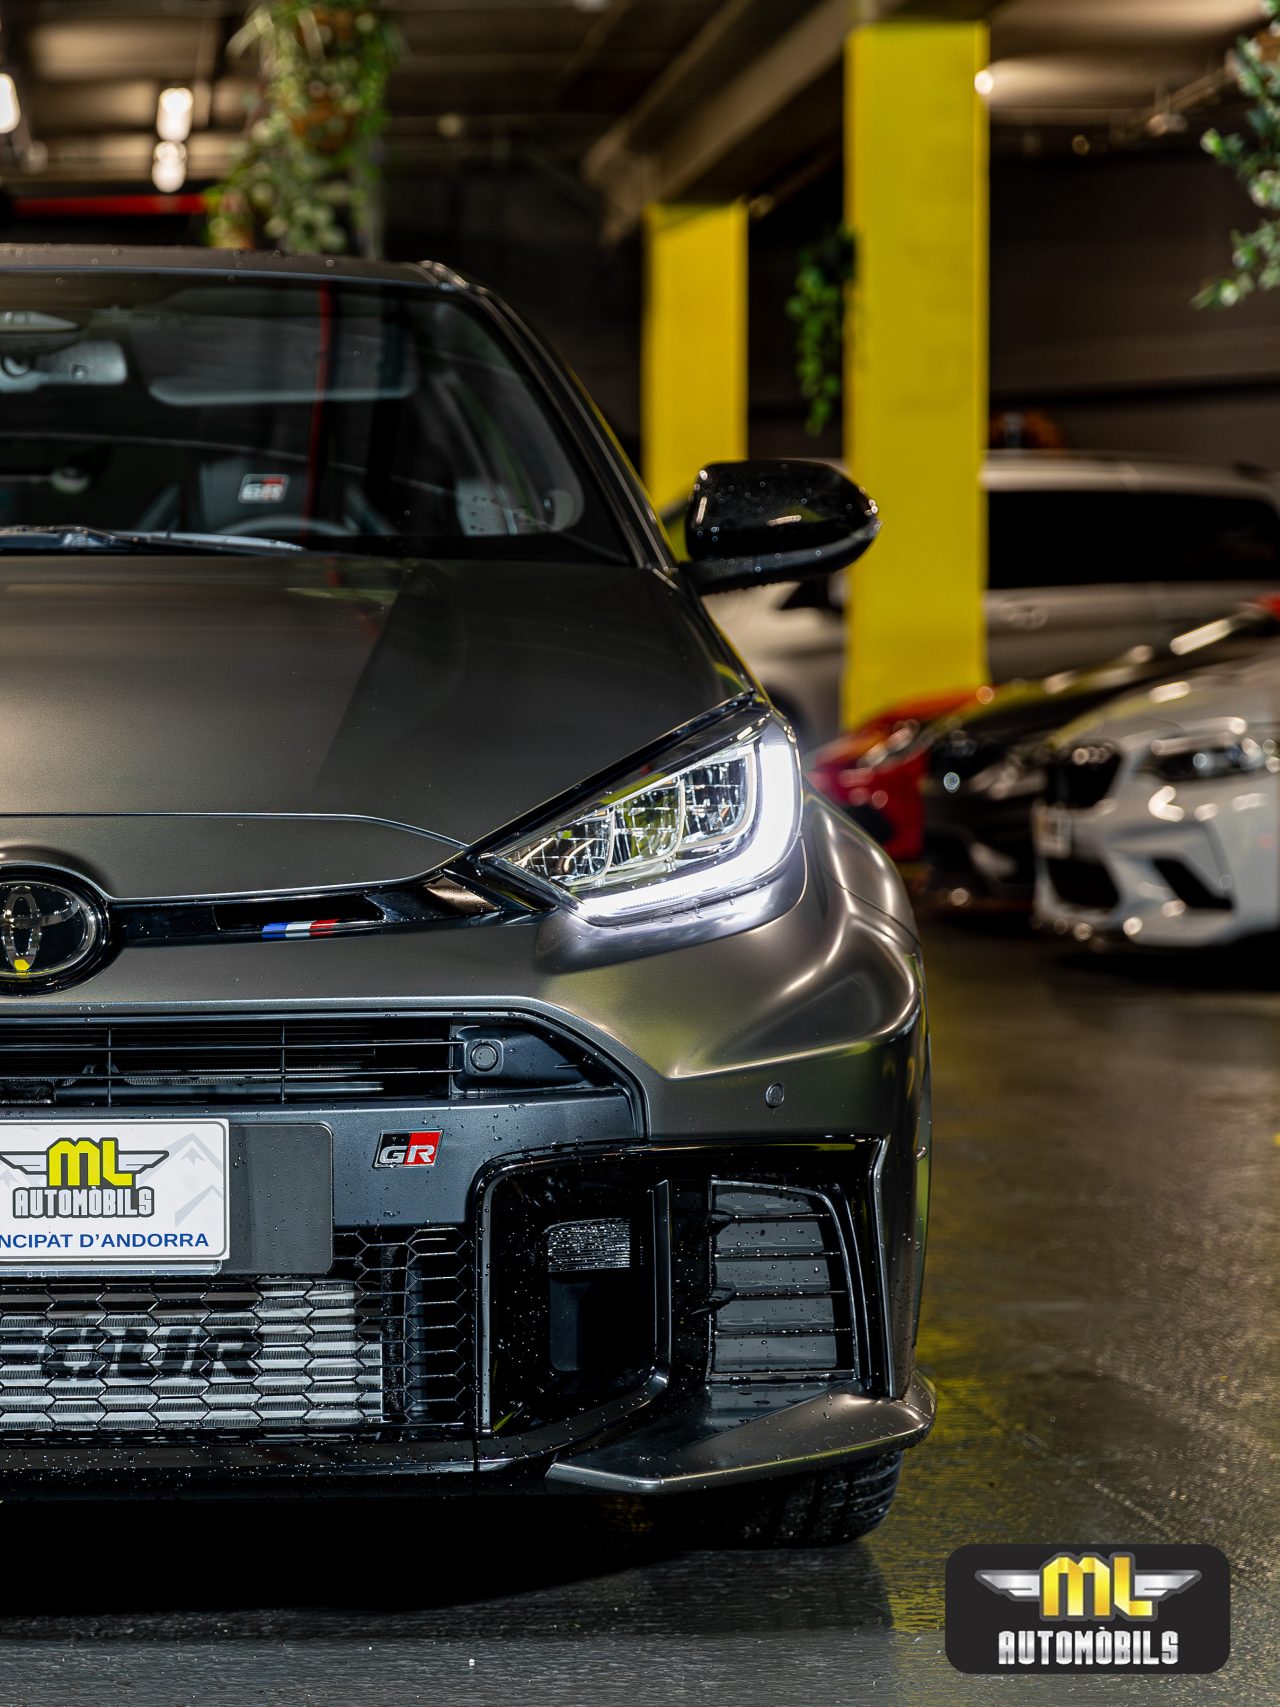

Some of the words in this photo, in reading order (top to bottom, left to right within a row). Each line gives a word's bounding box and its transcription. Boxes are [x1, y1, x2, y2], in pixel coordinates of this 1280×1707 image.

[48, 1139, 133, 1186] ML
[379, 1144, 435, 1164] GR
[79, 1233, 209, 1249] D’ANDORRA
